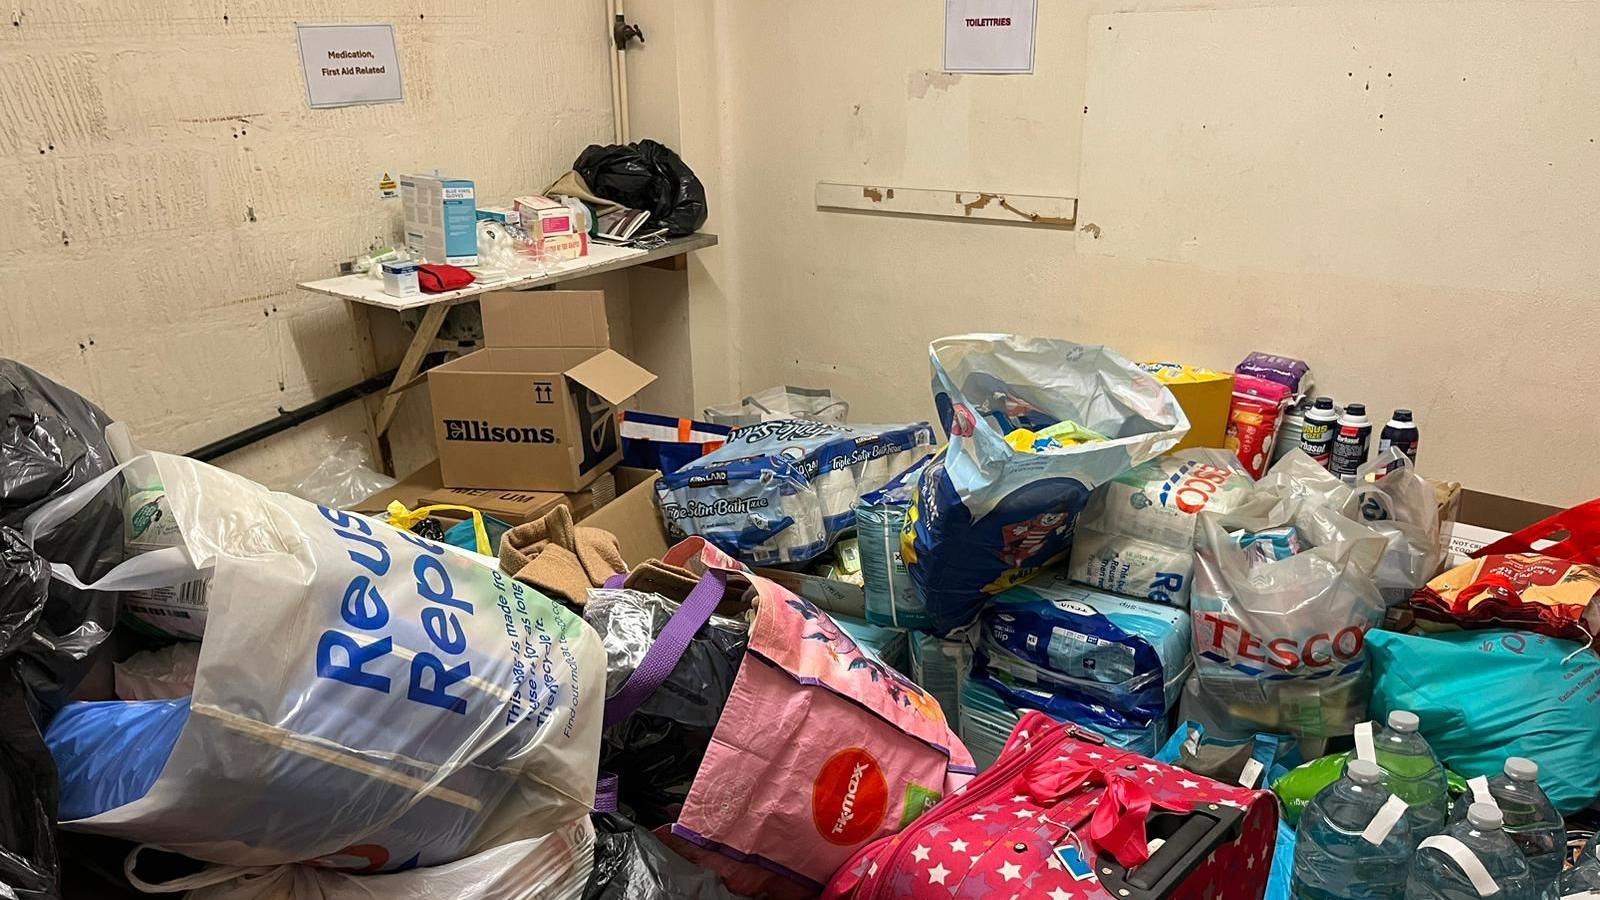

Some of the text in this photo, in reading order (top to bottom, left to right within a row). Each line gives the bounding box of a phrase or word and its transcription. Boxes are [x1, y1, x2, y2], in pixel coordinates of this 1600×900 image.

[965, 18, 1011, 27] TOILETTRIES
[328, 50, 374, 59] Medication,
[322, 65, 385, 76] First Aid Related
[1452, 539, 1469, 548] NOT
[511, 582, 526, 615] long
[498, 594, 518, 637] made
[521, 617, 532, 637] as
[511, 640, 521, 655] is
[524, 638, 539, 664] for
[1203, 614, 1364, 672] TESCO
[506, 690, 522, 727] This
[563, 705, 576, 739] Find
[572, 682, 580, 706] out
